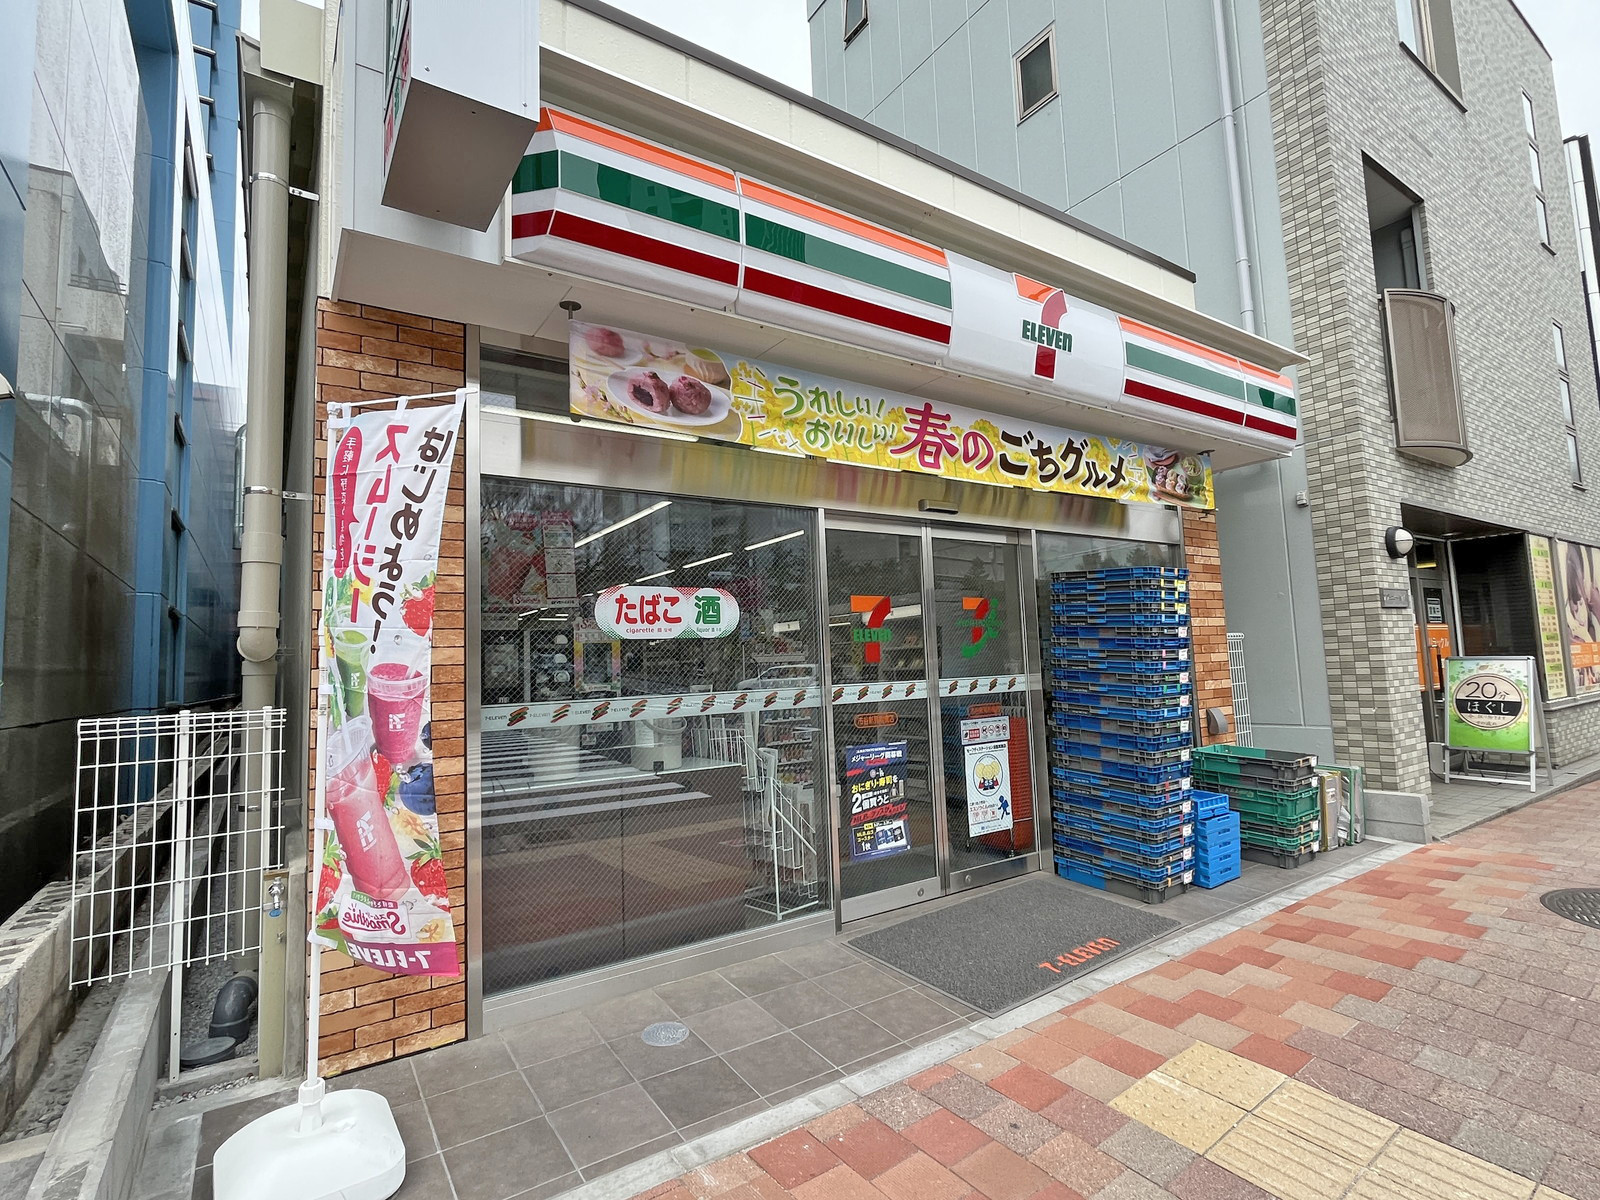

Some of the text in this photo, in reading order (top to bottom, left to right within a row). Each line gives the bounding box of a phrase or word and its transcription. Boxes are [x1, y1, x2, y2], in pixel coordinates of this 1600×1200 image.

[889, 402, 1127, 489] 春のごちグルメ
[615, 593, 682, 625] たばこ
[694, 595, 722, 625] 酒
[1465, 682, 1510, 700] 20分
[1467, 701, 1510, 714] ほぐし
